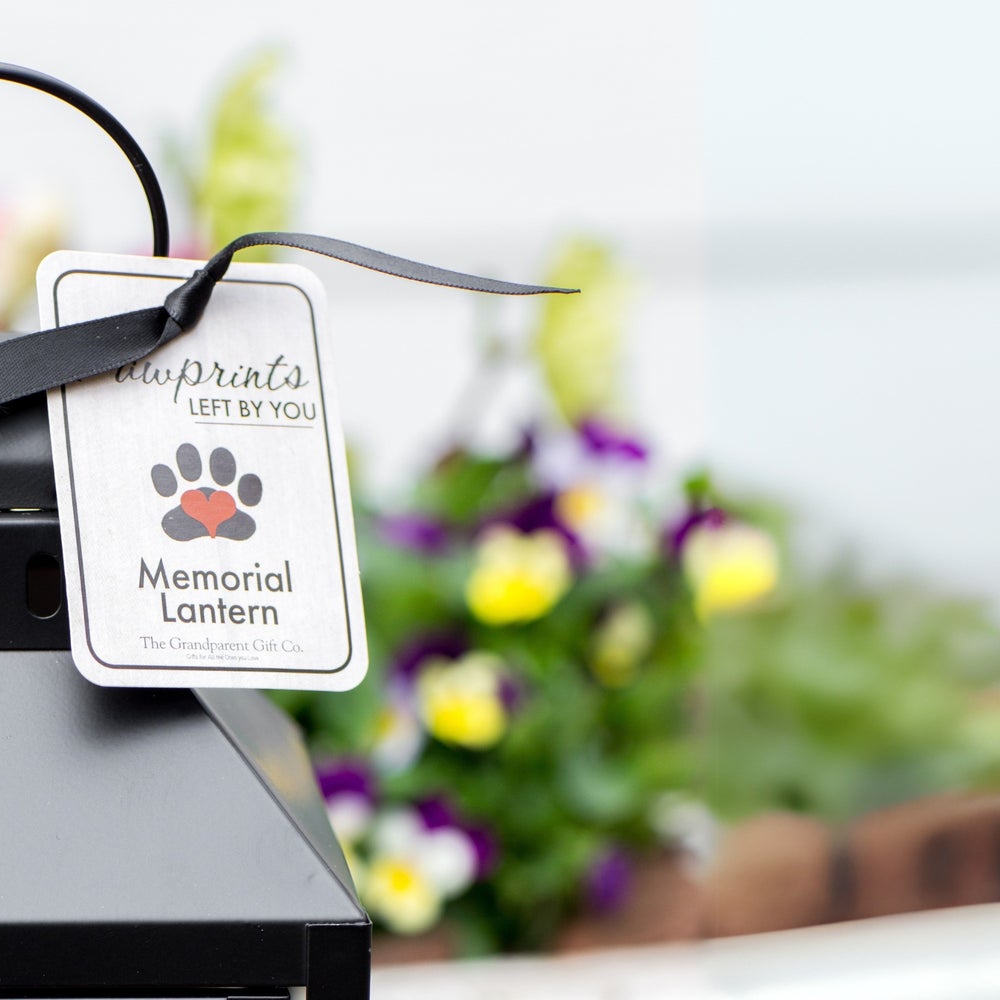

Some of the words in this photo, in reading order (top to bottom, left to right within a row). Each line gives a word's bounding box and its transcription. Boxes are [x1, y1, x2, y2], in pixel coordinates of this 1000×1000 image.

[114, 355, 309, 403] awprints
[189, 398, 231, 416] LEFT
[239, 400, 262, 418] BY
[269, 401, 316, 420] YOU
[139, 557, 293, 592] Memorial
[161, 592, 279, 625] Lantern
[140, 636, 166, 649] The
[170, 637, 249, 653] Grandparent
[253, 639, 277, 652] Gift
[282, 640, 303, 653] Co.
